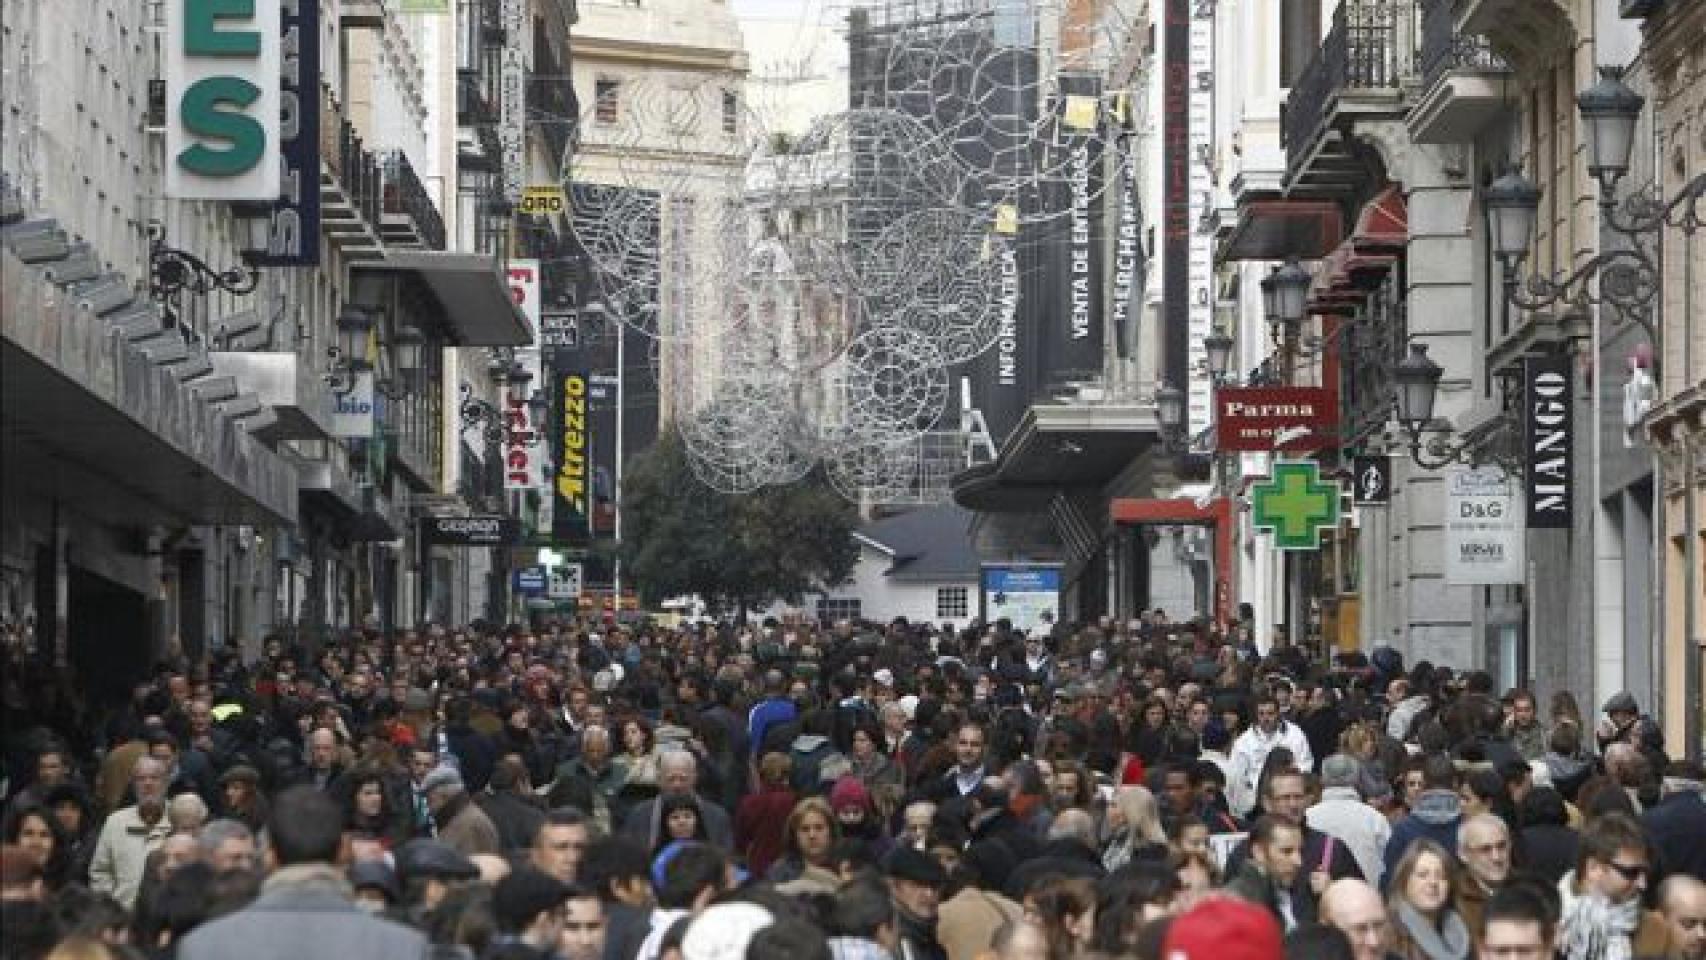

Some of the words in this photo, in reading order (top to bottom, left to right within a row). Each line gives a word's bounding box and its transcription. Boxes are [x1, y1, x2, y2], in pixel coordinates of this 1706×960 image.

[1071, 147, 1089, 244] ENTRADAS
[1072, 248, 1089, 273] DE
[1072, 277, 1089, 339] VENTA
[1225, 401, 1314, 417] Parma
[1534, 372, 1566, 512] MANGO
[1460, 500, 1502, 518] D&G
